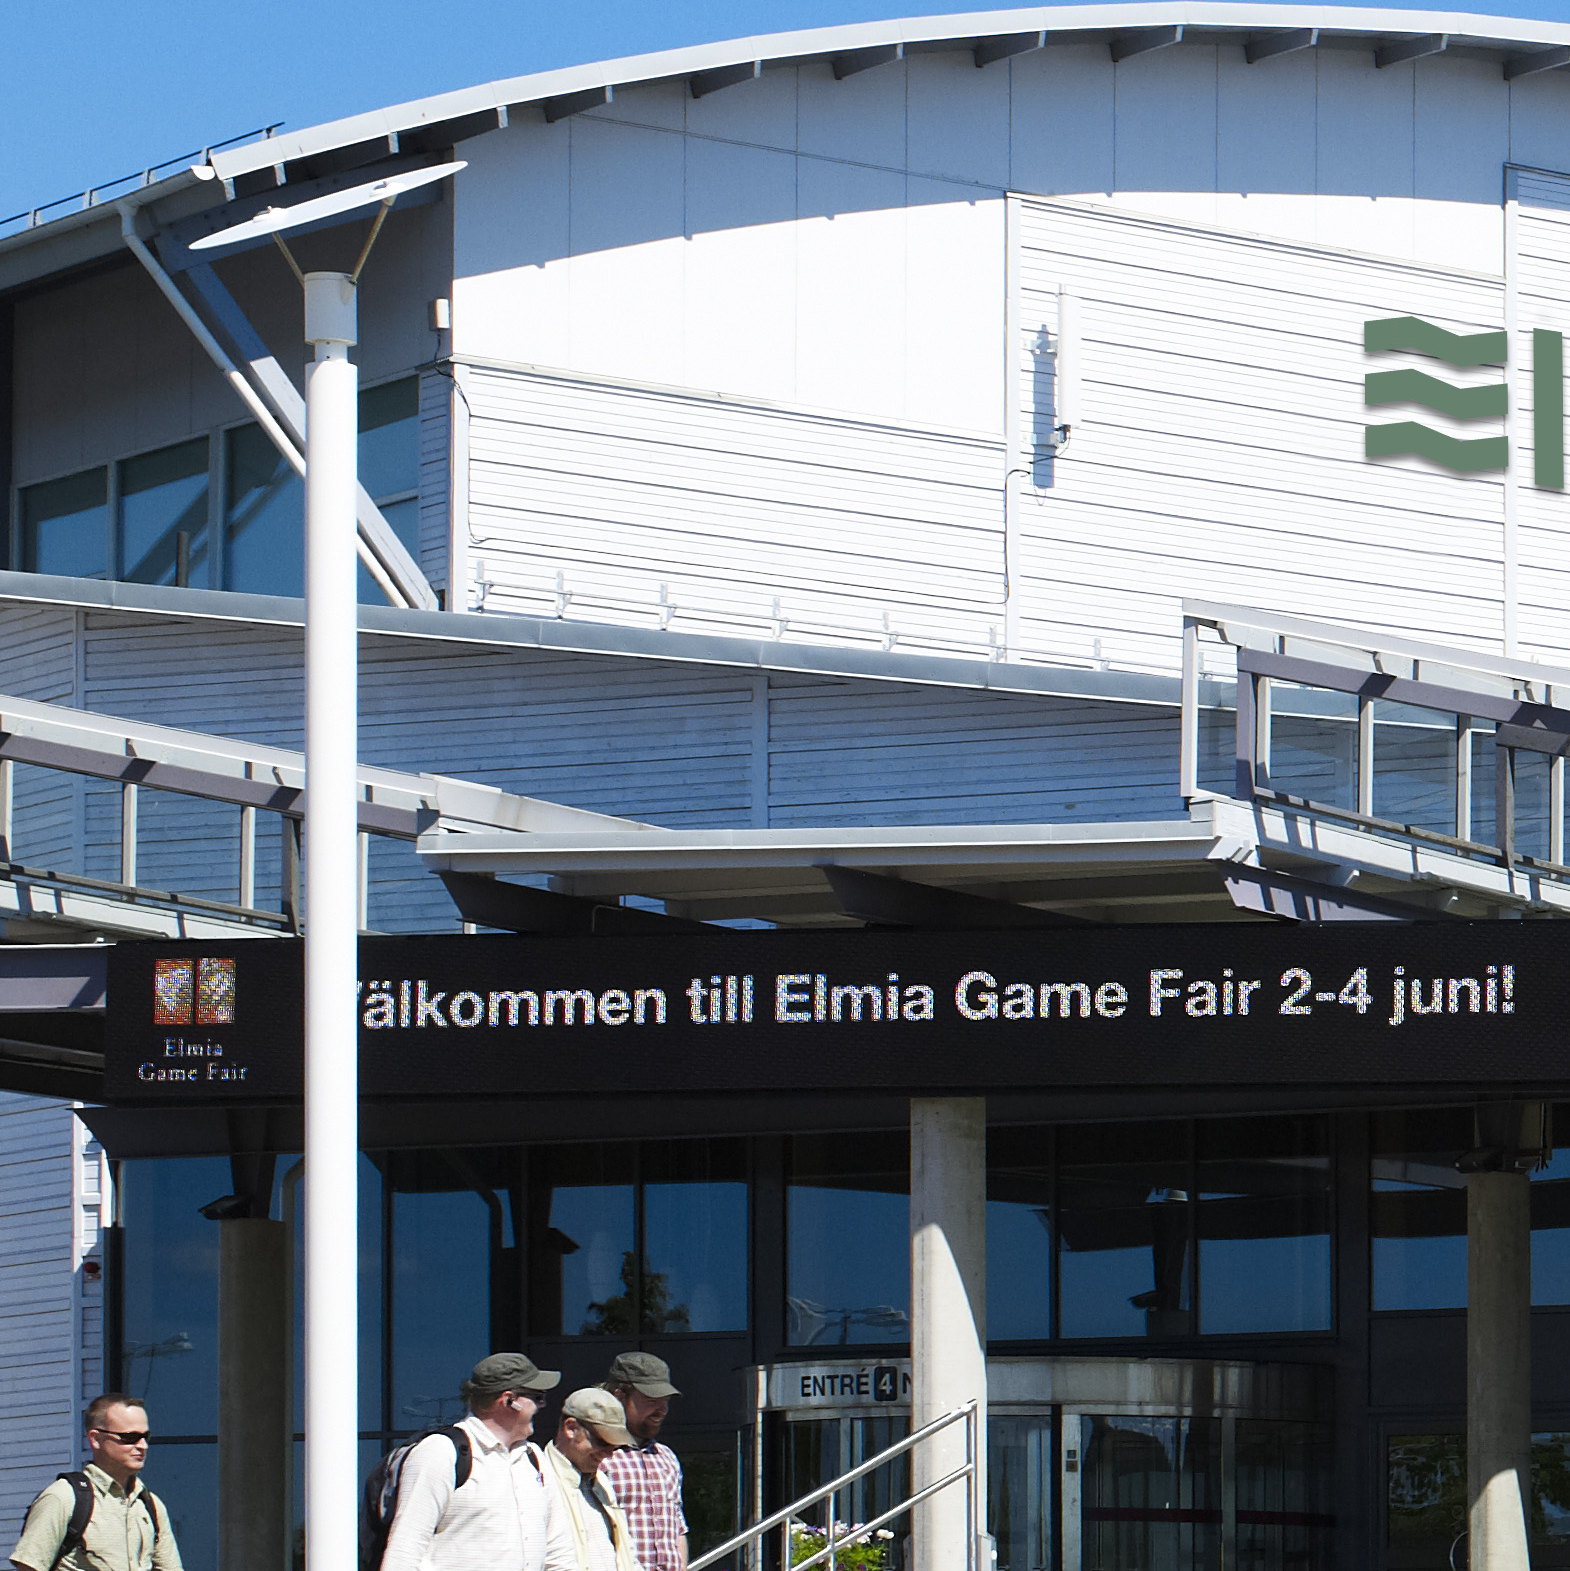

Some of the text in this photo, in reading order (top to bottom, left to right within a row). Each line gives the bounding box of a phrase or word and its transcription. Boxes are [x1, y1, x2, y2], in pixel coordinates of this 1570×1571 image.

[357, 964, 1516, 1029] älkommen till Elmia Game Fair 2-4 juni!
[163, 1036, 223, 1057] Elmia
[137, 1061, 249, 1082] Game Fair
[801, 1367, 870, 1397] ENTRÉ
